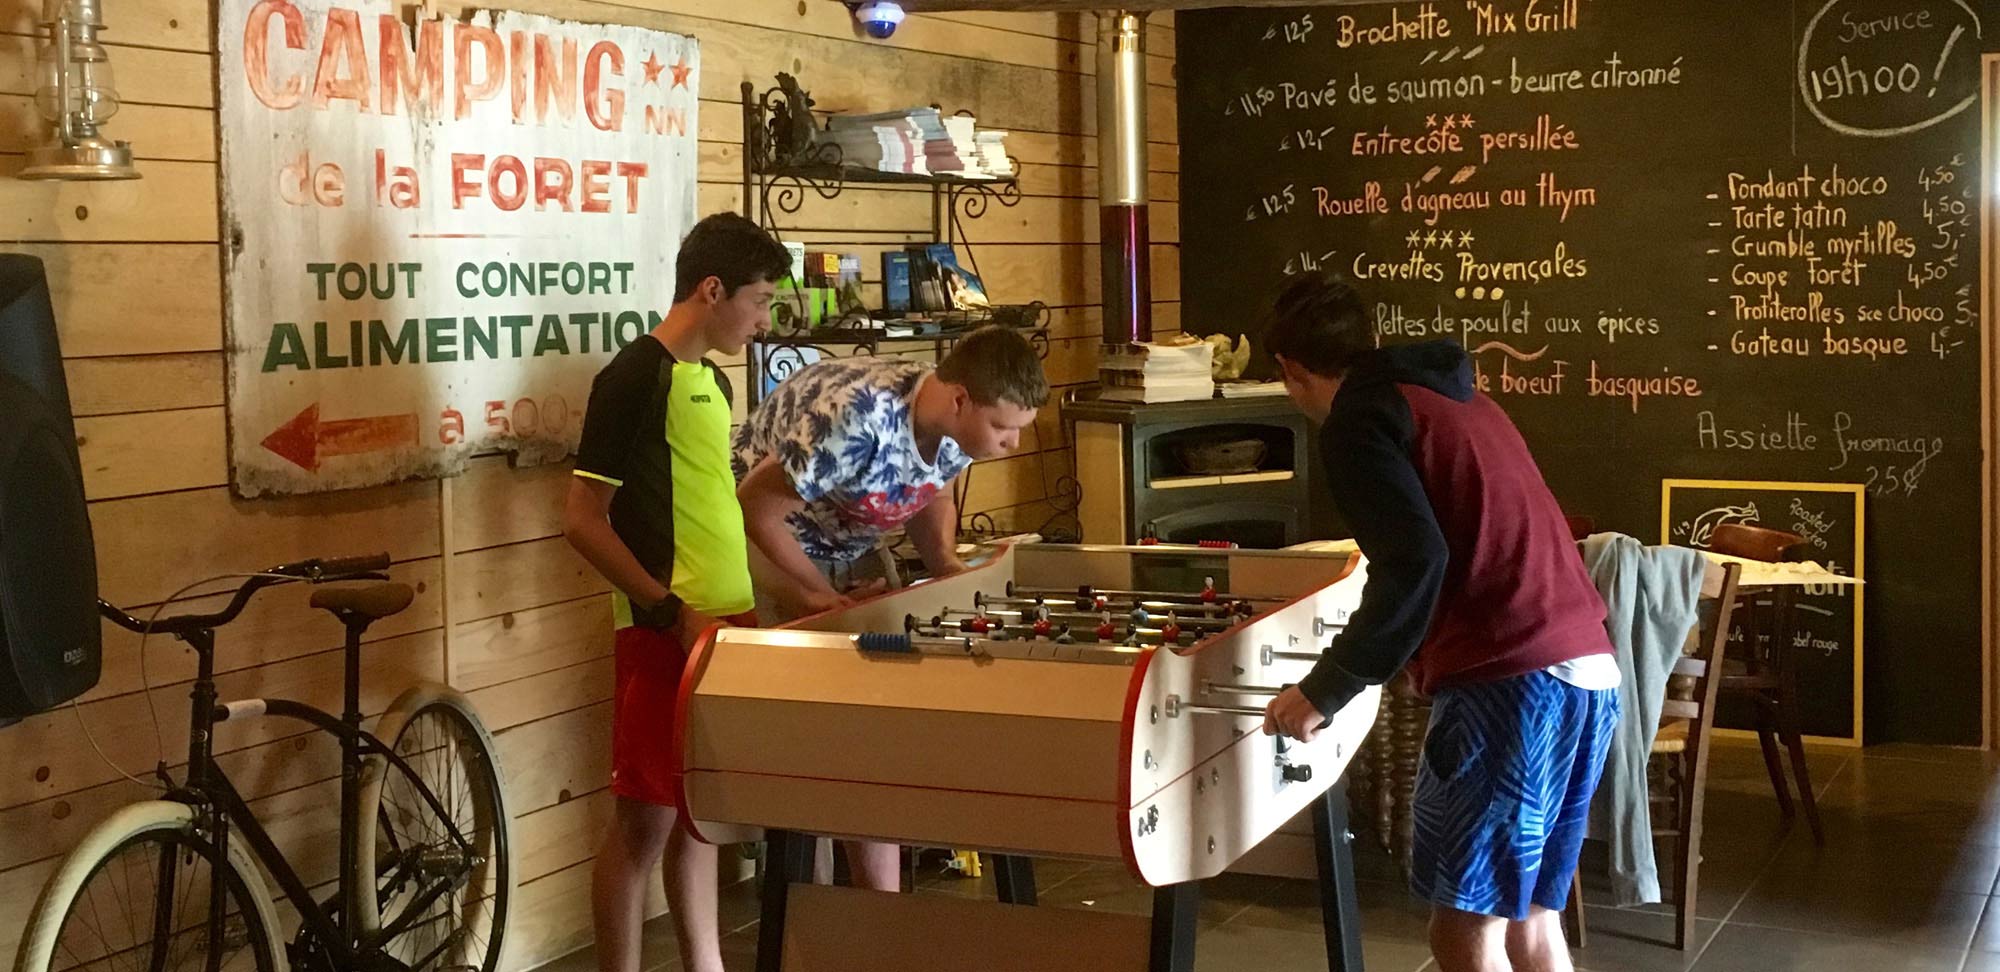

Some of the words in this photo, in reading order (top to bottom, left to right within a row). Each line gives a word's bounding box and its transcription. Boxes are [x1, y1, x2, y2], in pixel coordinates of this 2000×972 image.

[1337, 3, 1451, 48] Brochette
[1838, 10, 1933, 43] Service
[243, 0, 625, 133] CAMPING
[1278, 79, 1336, 109] Pavé
[1348, 72, 1376, 104] de
[1388, 74, 1485, 103] saumon
[1510, 56, 1584, 94] beurre
[1591, 51, 1683, 88] citronné
[645, 104, 686, 137] NN
[1352, 125, 1463, 156] Entrecôte
[1480, 114, 1579, 163] persillée
[279, 145, 344, 208] de
[375, 148, 421, 209] la
[451, 153, 649, 214] FORET
[1312, 181, 1390, 217] Rouelle
[1401, 180, 1489, 226] d'agneau
[1500, 188, 1526, 207] au
[1536, 172, 1596, 223] thym
[1728, 164, 1815, 200] Fondant
[1821, 164, 1888, 197] choco
[1731, 203, 1785, 229] Tarte
[1792, 200, 1846, 229] tatin
[1731, 229, 1815, 257] Crumble
[1828, 220, 1916, 263] myrtilles
[307, 262, 422, 300] TOUT
[456, 261, 634, 299] CONFORT
[1353, 250, 1444, 282] Crevettes
[1456, 241, 1587, 284] Provençales
[1731, 263, 1788, 296] Coupe
[1432, 304, 1454, 333] de
[1461, 299, 1531, 350] poulet
[1545, 317, 1582, 333] aux
[1597, 308, 1660, 343] épices
[1729, 291, 1845, 324] Profiterolles
[1888, 289, 1944, 322] choco
[1731, 327, 1809, 357] Gateau
[1824, 327, 1908, 361] basque
[1500, 356, 1569, 394] boeuf
[1586, 360, 1702, 413] basquaise
[1697, 410, 1817, 450] Assiette
[1790, 497, 1836, 533] Roasted
[1812, 638, 1840, 656] rouge
